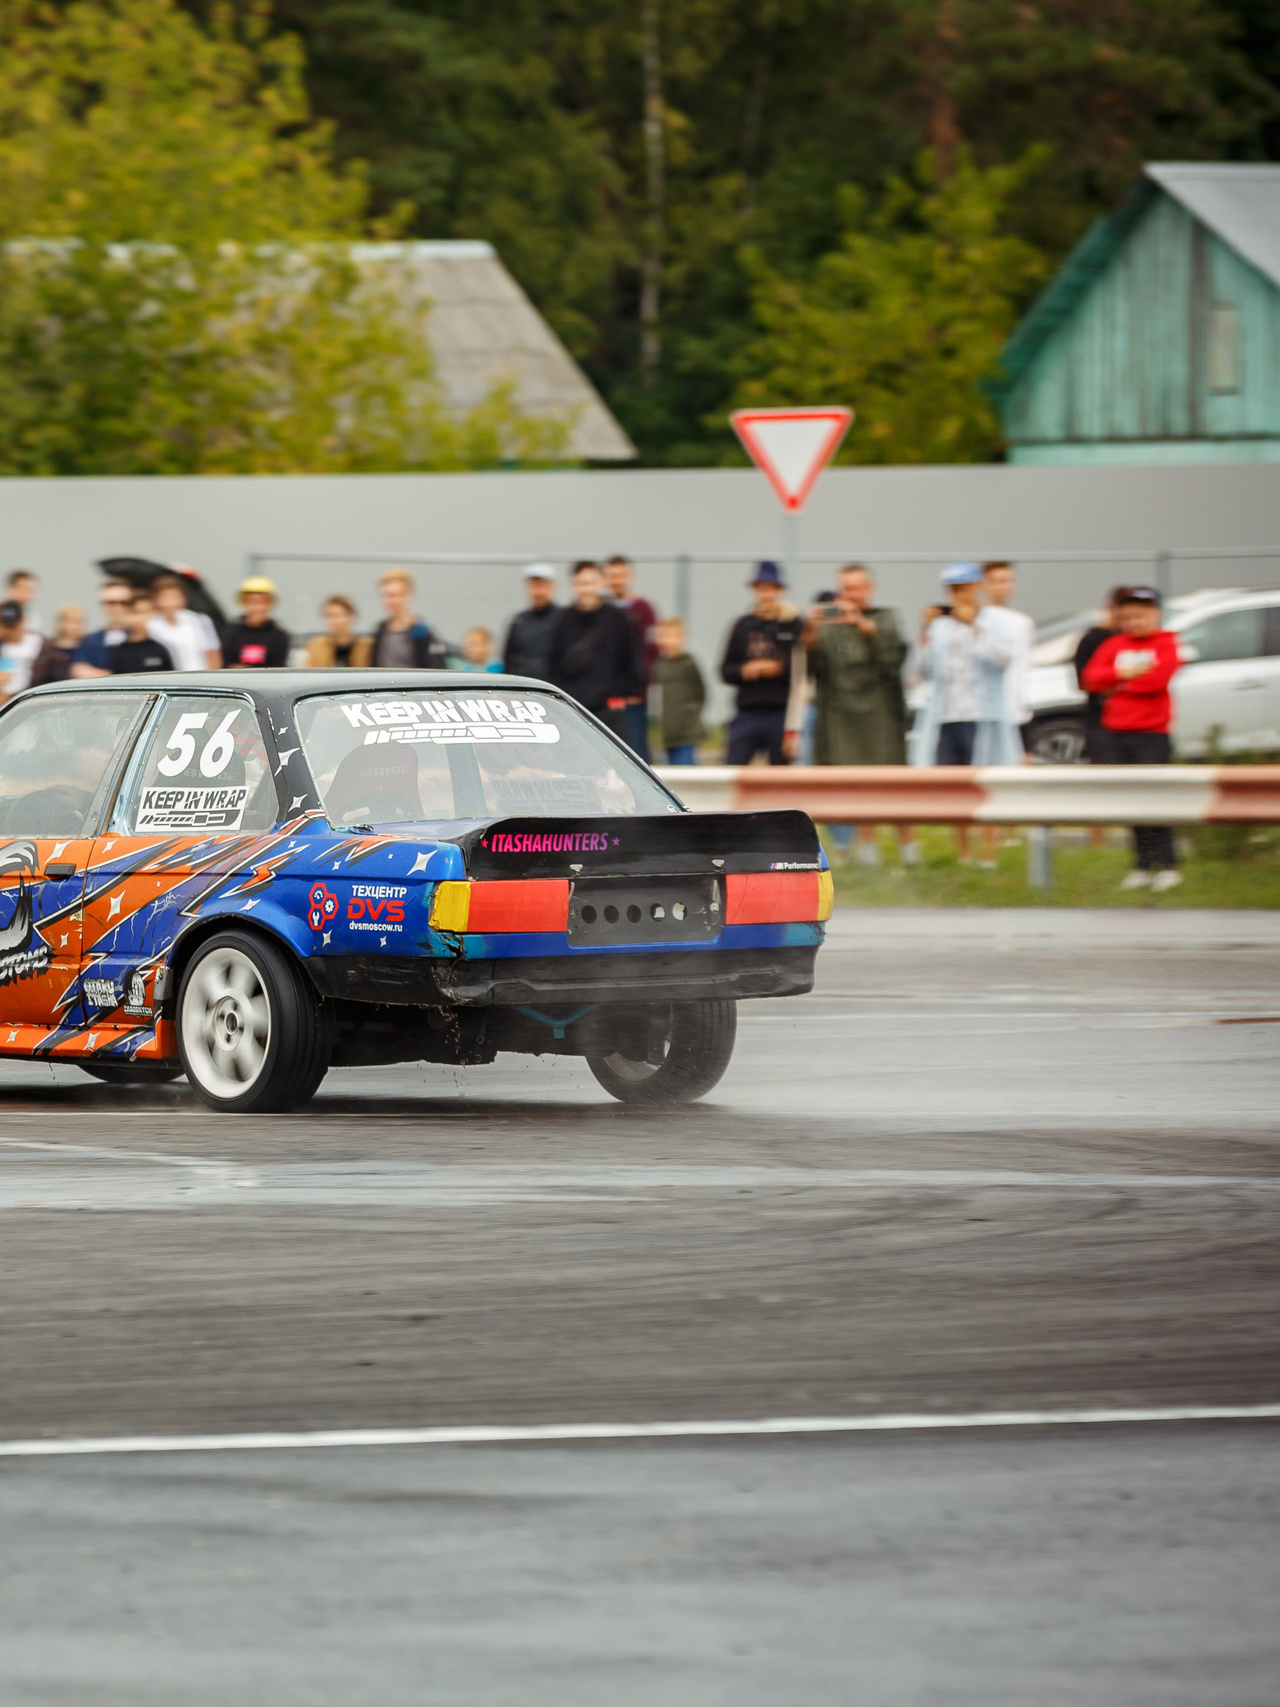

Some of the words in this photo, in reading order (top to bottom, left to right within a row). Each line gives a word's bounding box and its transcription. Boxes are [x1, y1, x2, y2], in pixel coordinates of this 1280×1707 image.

[340, 701, 423, 728] KEEP
[421, 699, 463, 723] IN
[457, 699, 547, 723] WRAP
[157, 709, 241, 778] 56
[359, 765, 410, 778] BRIDE
[142, 790, 185, 809] KEEP
[183, 790, 204, 809] IN
[203, 789, 247, 809] WRAP
[491, 832, 609, 853] ITASHAHUNTERS
[784, 862, 820, 870] Performanc
[352, 885, 407, 899] ТЕХЦЕНТР
[347, 898, 405, 922] DVS
[349, 920, 403, 932] dvsmoscow.ru
